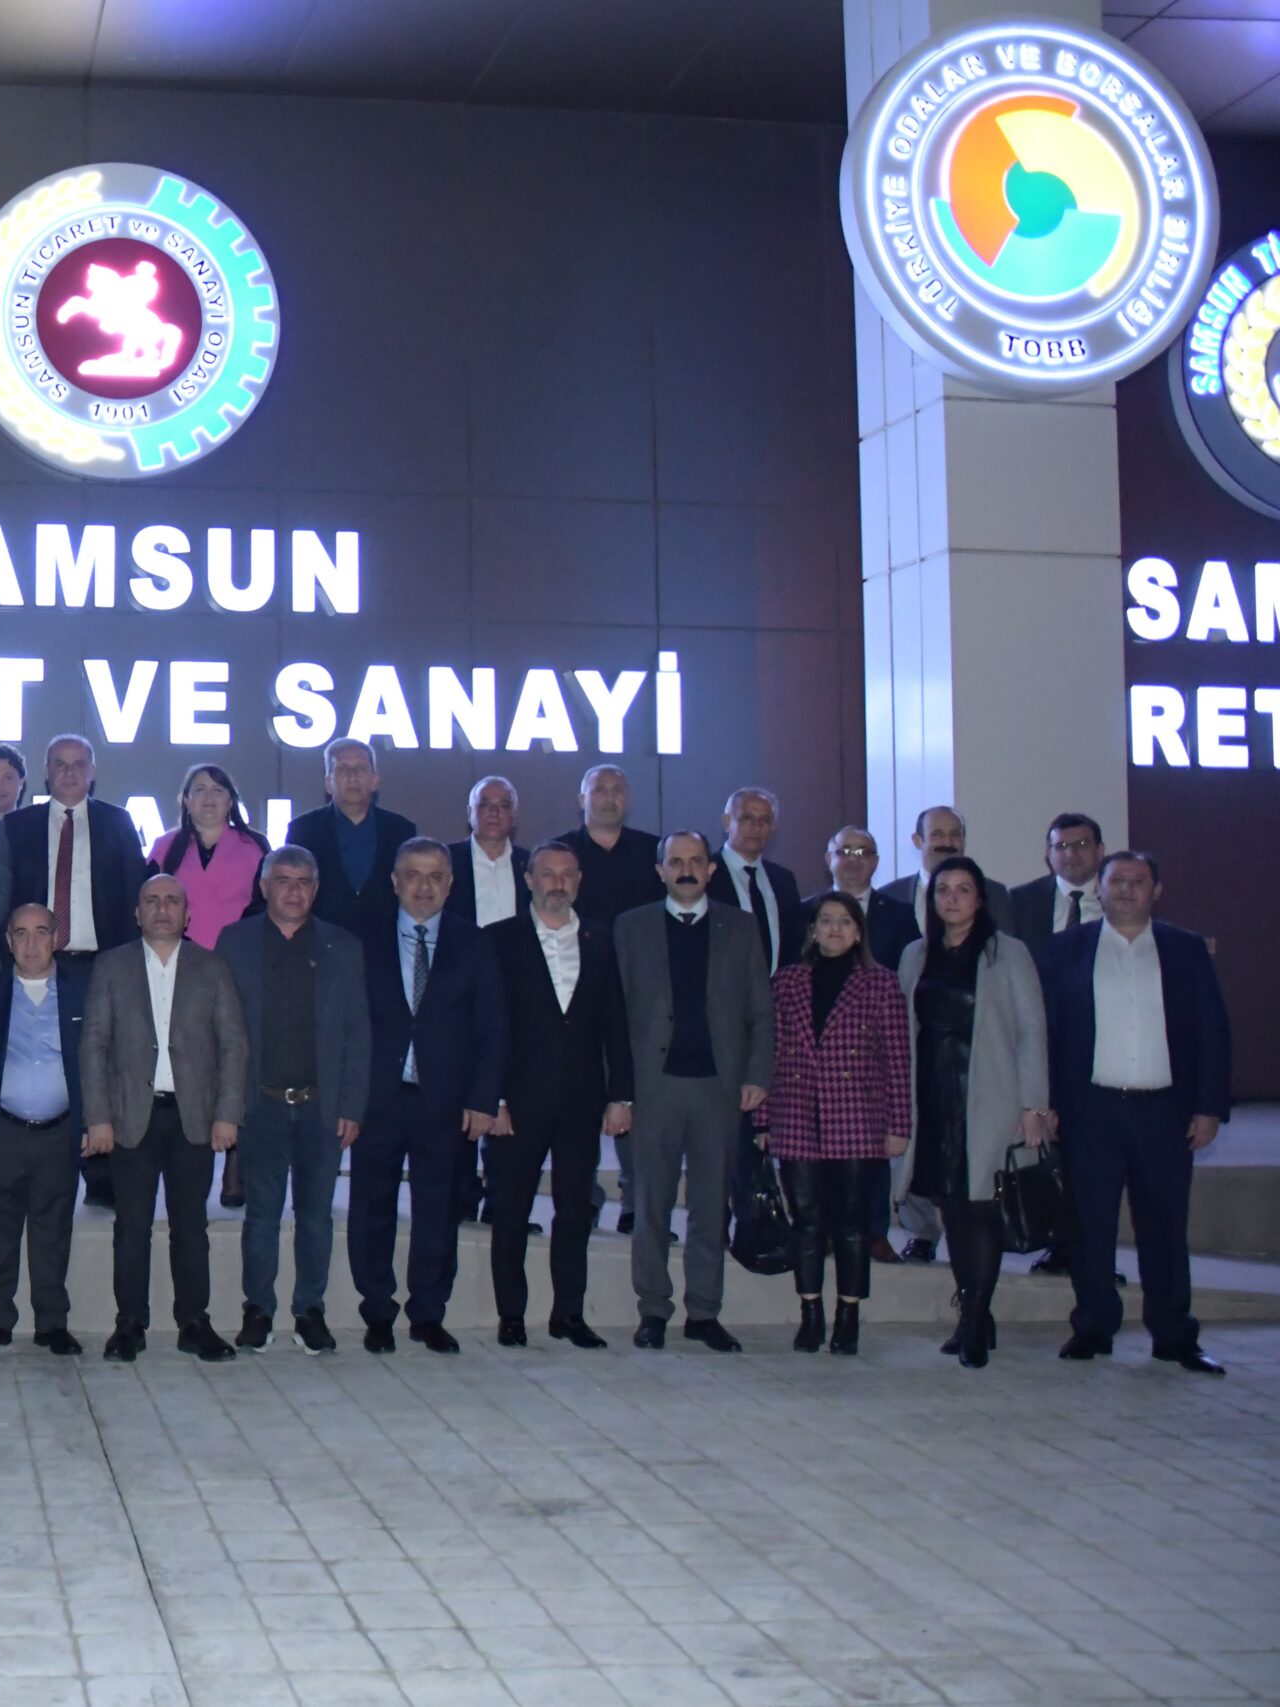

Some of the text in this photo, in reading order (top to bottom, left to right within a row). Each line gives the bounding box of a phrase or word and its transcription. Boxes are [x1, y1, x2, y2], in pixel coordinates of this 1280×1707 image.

[888, 54, 988, 161] ODALAR
[995, 43, 1041, 71] VE
[1055, 49, 1186, 201] BORSALAR
[12, 292, 68, 400] SAMSUN
[170, 330, 225, 403] ODASI
[1000, 331, 1088, 361] TOBB
[1189, 264, 1253, 395] SAMSUN
[91, 402, 151, 422] 1901
[83, 659, 231, 746] VE
[272, 651, 682, 755] SANAYİ
